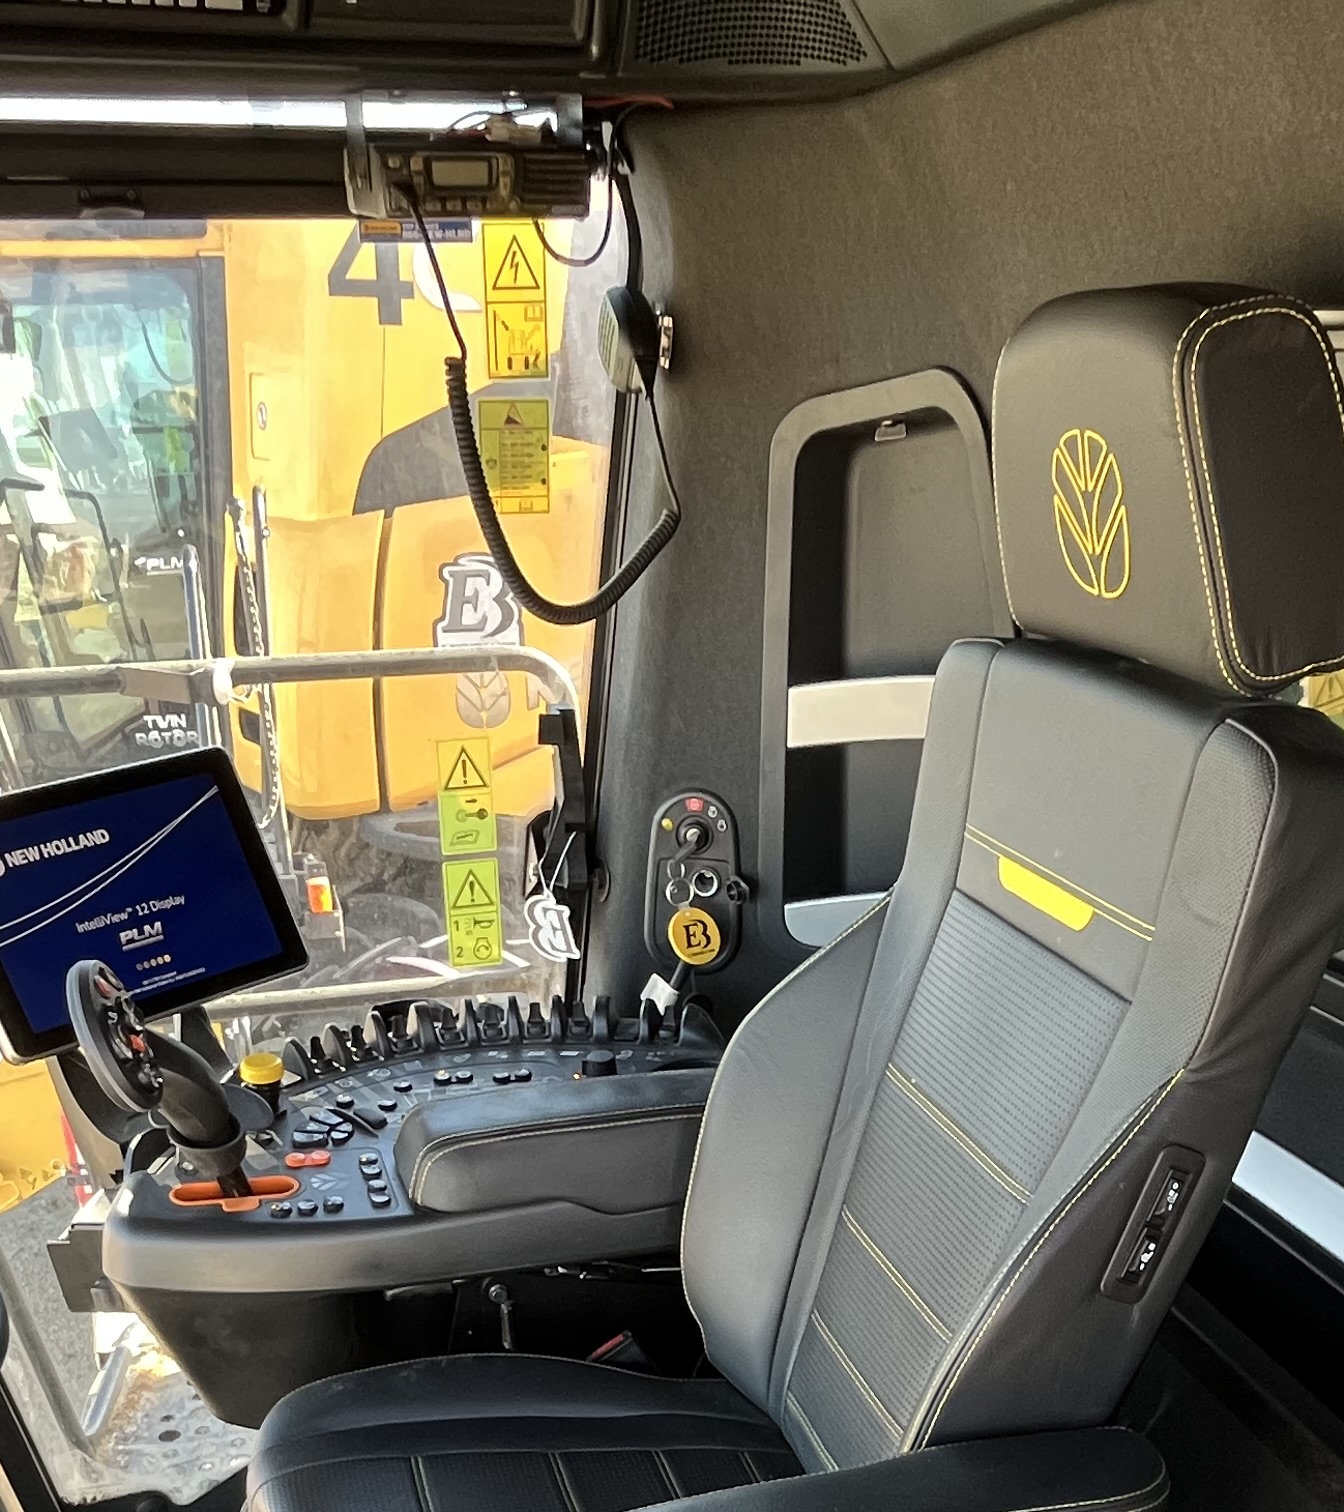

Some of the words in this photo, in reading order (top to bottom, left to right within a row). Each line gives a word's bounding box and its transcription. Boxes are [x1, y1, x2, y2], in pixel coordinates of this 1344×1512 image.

[143, 713, 187, 729] TWIN
[135, 728, 200, 749] ROTOR
[4, 845, 41, 868] NEW
[39, 828, 110, 859] HOLLAND
[135, 902, 150, 917] 12
[149, 895, 185, 912] Display
[119, 920, 163, 946] PLM
[453, 919, 460, 932] 1
[455, 945, 464, 958] 2
